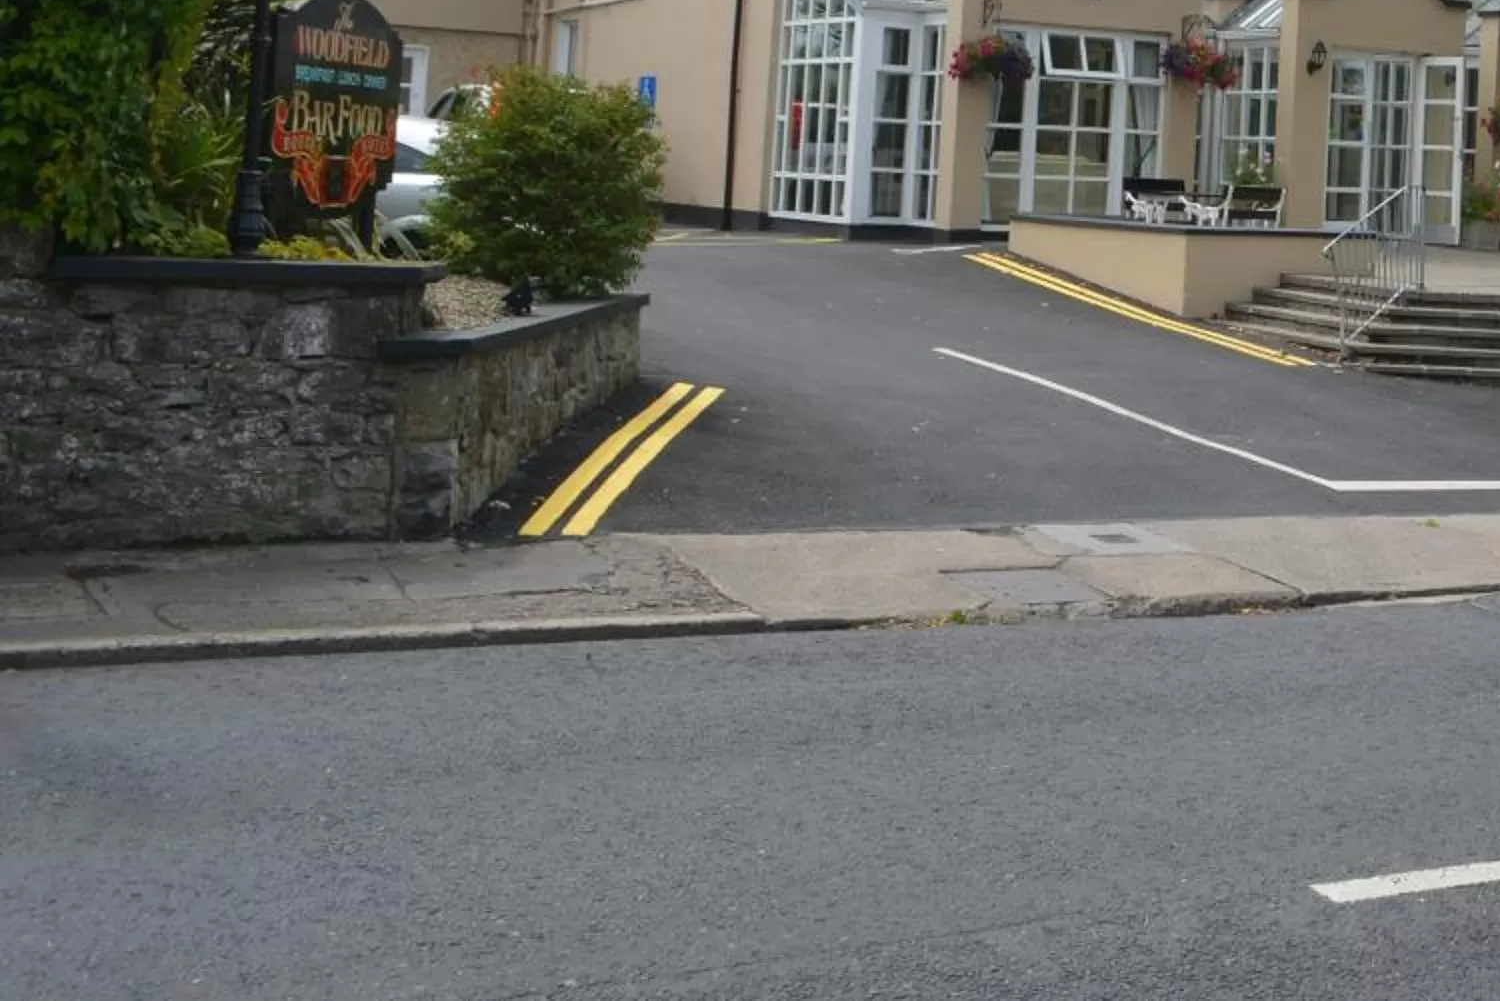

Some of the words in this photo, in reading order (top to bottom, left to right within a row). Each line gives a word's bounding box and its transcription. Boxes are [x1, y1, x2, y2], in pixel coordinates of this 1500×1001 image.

[296, 25, 389, 68] WOODFIELD
[293, 90, 337, 146] BAR
[337, 94, 383, 139] FOOD
